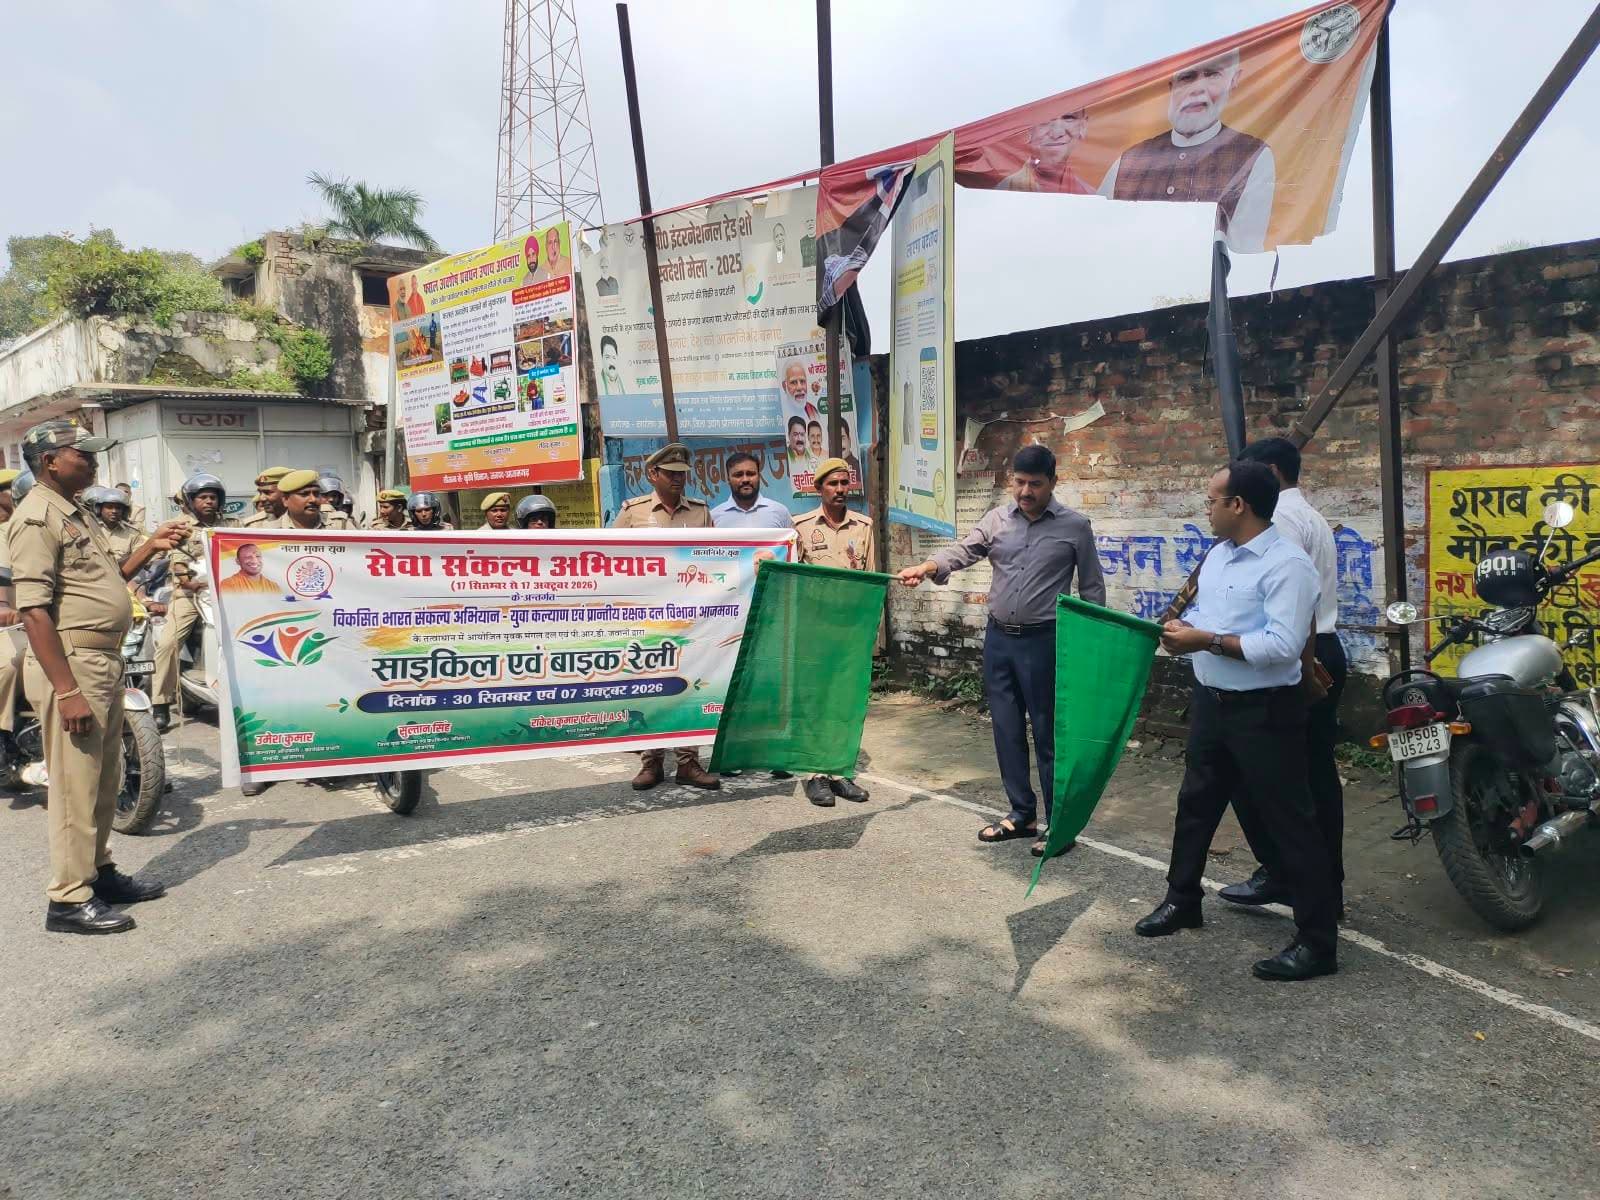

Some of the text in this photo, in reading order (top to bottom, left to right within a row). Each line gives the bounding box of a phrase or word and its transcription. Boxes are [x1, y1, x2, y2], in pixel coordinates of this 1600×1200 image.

[669, 221, 722, 250] इंटरनेशनल
[686, 255, 708, 279] मेला
[716, 253, 742, 276] 2025
[176, 413, 246, 427] पराग
[1450, 474, 1599, 524] शराब की
[304, 544, 324, 554] मुक्त
[328, 545, 346, 555] युवा
[365, 548, 667, 577] सेवा संकल्प अभियान
[1477, 556, 1516, 577] 1901
[451, 580, 465, 592] (17
[509, 580, 519, 590] से
[522, 582, 530, 590] 17
[571, 580, 598, 591] 2026)
[333, 608, 379, 627] विकसित
[382, 611, 412, 627] भारत
[415, 607, 450, 626] संकल्प
[453, 606, 500, 626] अभियान
[510, 608, 529, 629] युवा
[531, 609, 569, 623] कल्याण
[571, 604, 585, 621] एवं
[622, 607, 647, 621] रक्षक
[648, 607, 663, 620] दल
[666, 603, 697, 620] विभाग
[699, 604, 740, 620] आजमगढ़
[412, 633, 421, 643] के
[467, 631, 500, 641] आयोजित
[503, 632, 522, 643] युवक
[525, 630, 543, 639] मंगल
[545, 631, 556, 639] दल
[558, 629, 569, 640] एवं
[372, 641, 678, 683] साइकिल एवं बाइक रैली
[388, 693, 437, 708] दिनांक
[452, 694, 472, 705] 30
[478, 689, 533, 705] सितम्बर
[536, 687, 557, 701] एवं
[561, 690, 577, 699] 07
[581, 685, 628, 700] अक्टूबर
[631, 683, 663, 696] 2026
[398, 720, 452, 739] सुल्तान सिंह
[531, 715, 554, 728] राकेश
[555, 715, 579, 728] कुमार
[580, 712, 599, 725] पटेल
[255, 731, 314, 747] उमेश कुमार
[1398, 726, 1439, 746] UP50B
